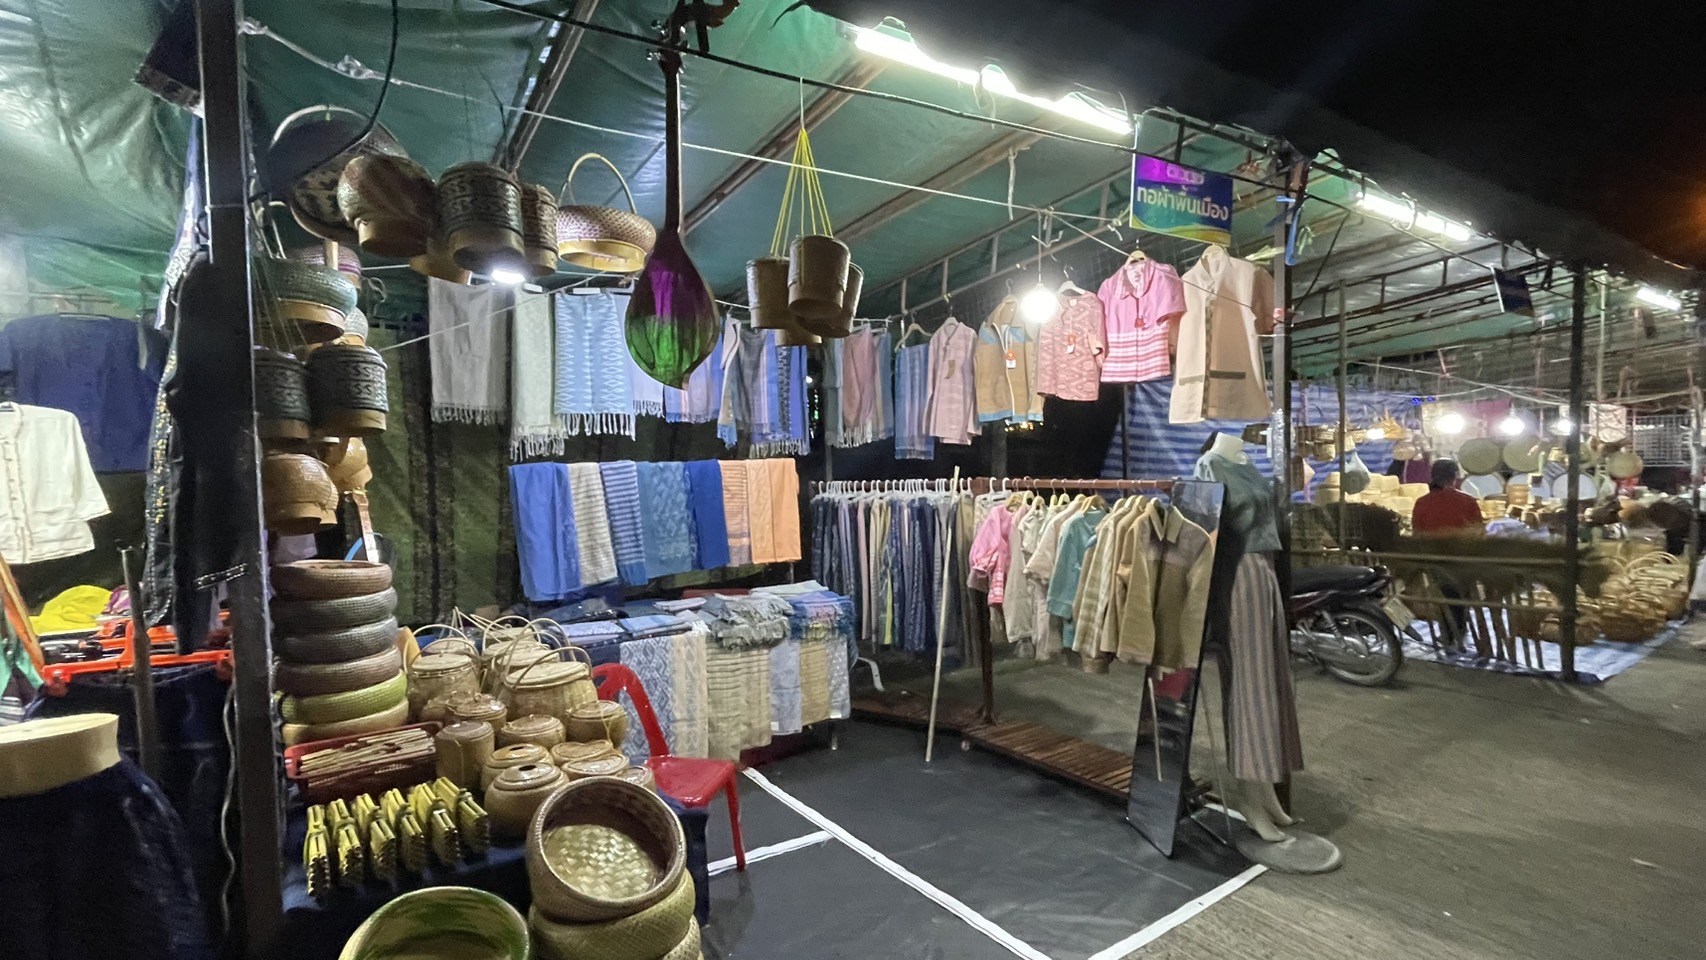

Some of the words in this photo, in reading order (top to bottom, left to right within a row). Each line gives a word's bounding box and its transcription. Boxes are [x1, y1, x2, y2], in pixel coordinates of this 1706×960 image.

[1136, 185, 1229, 221] ทอผ้าพื้นเมือง
